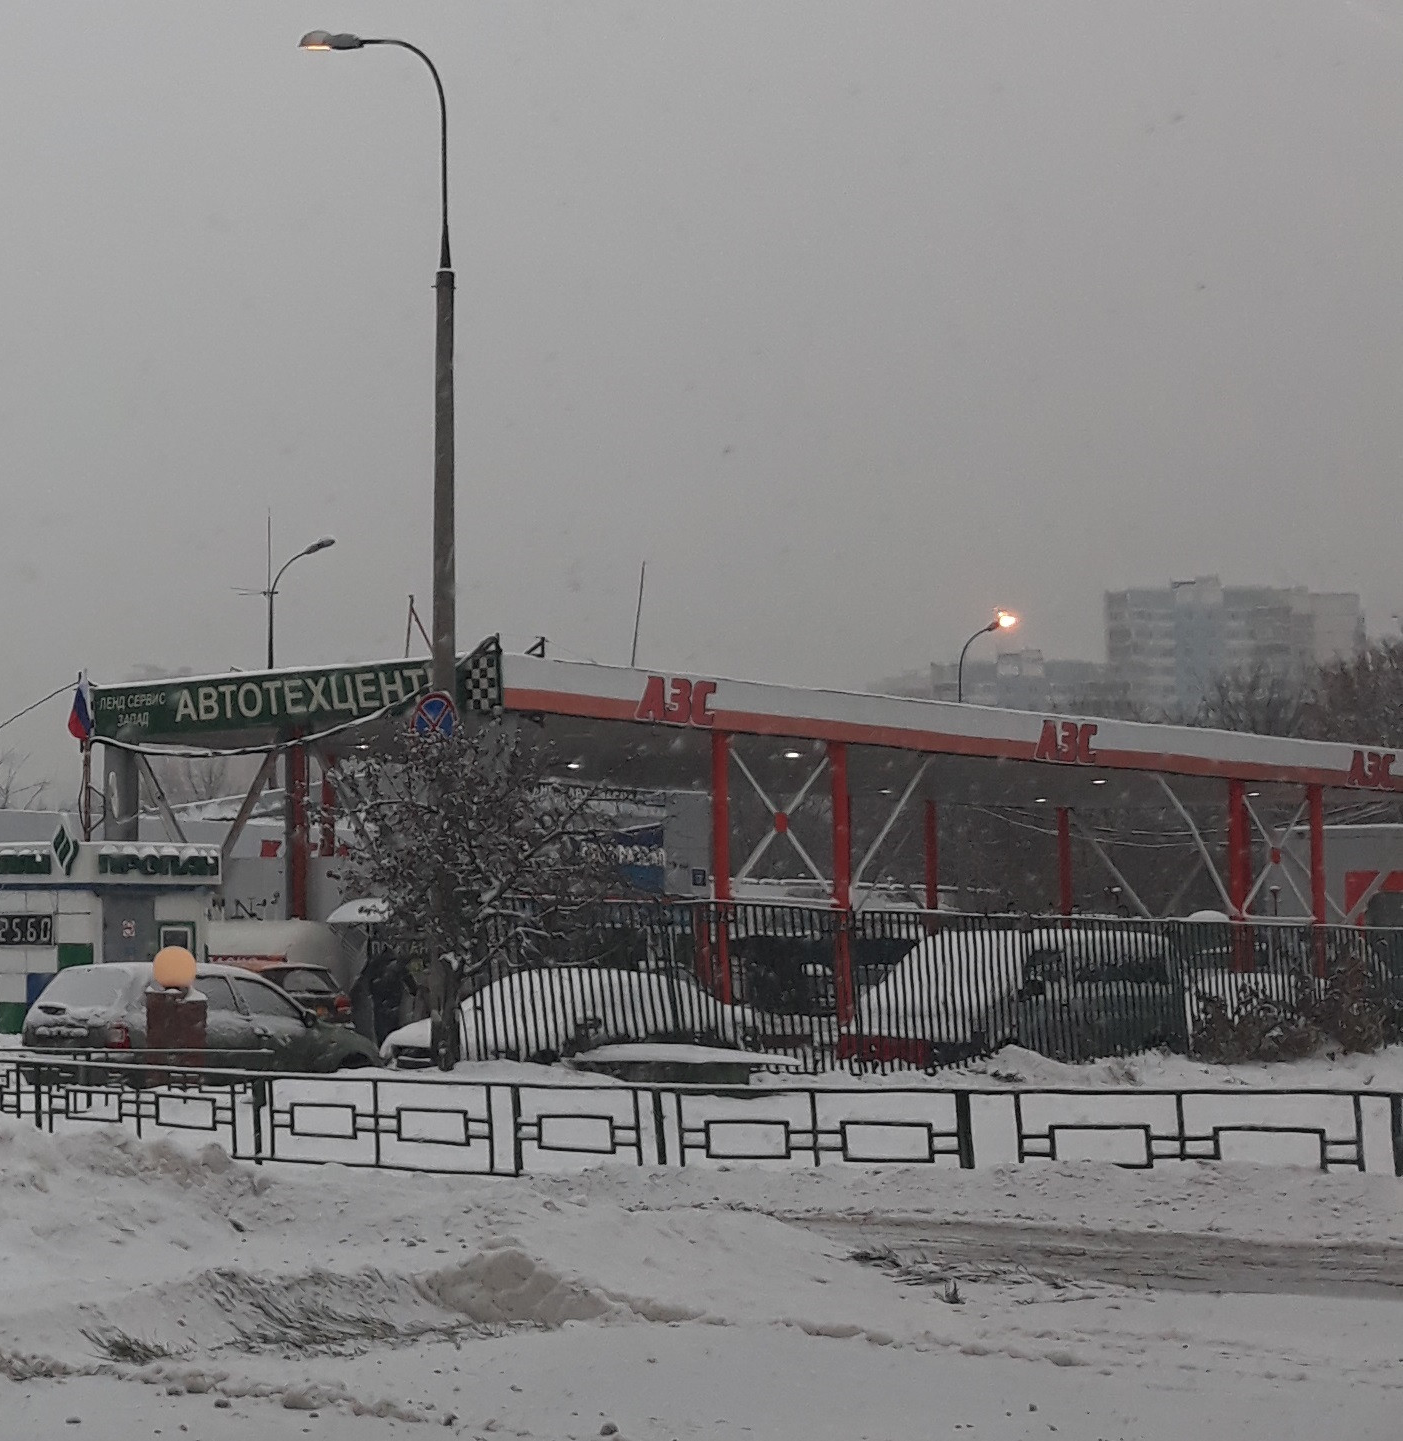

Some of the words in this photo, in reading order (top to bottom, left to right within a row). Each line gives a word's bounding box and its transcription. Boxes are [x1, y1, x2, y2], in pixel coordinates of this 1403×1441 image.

[127, 692, 166, 708] СЕРВИС
[636, 675, 717, 726] АЗС
[1036, 719, 1098, 763] АЗС
[1347, 749, 1396, 788] АЗС
